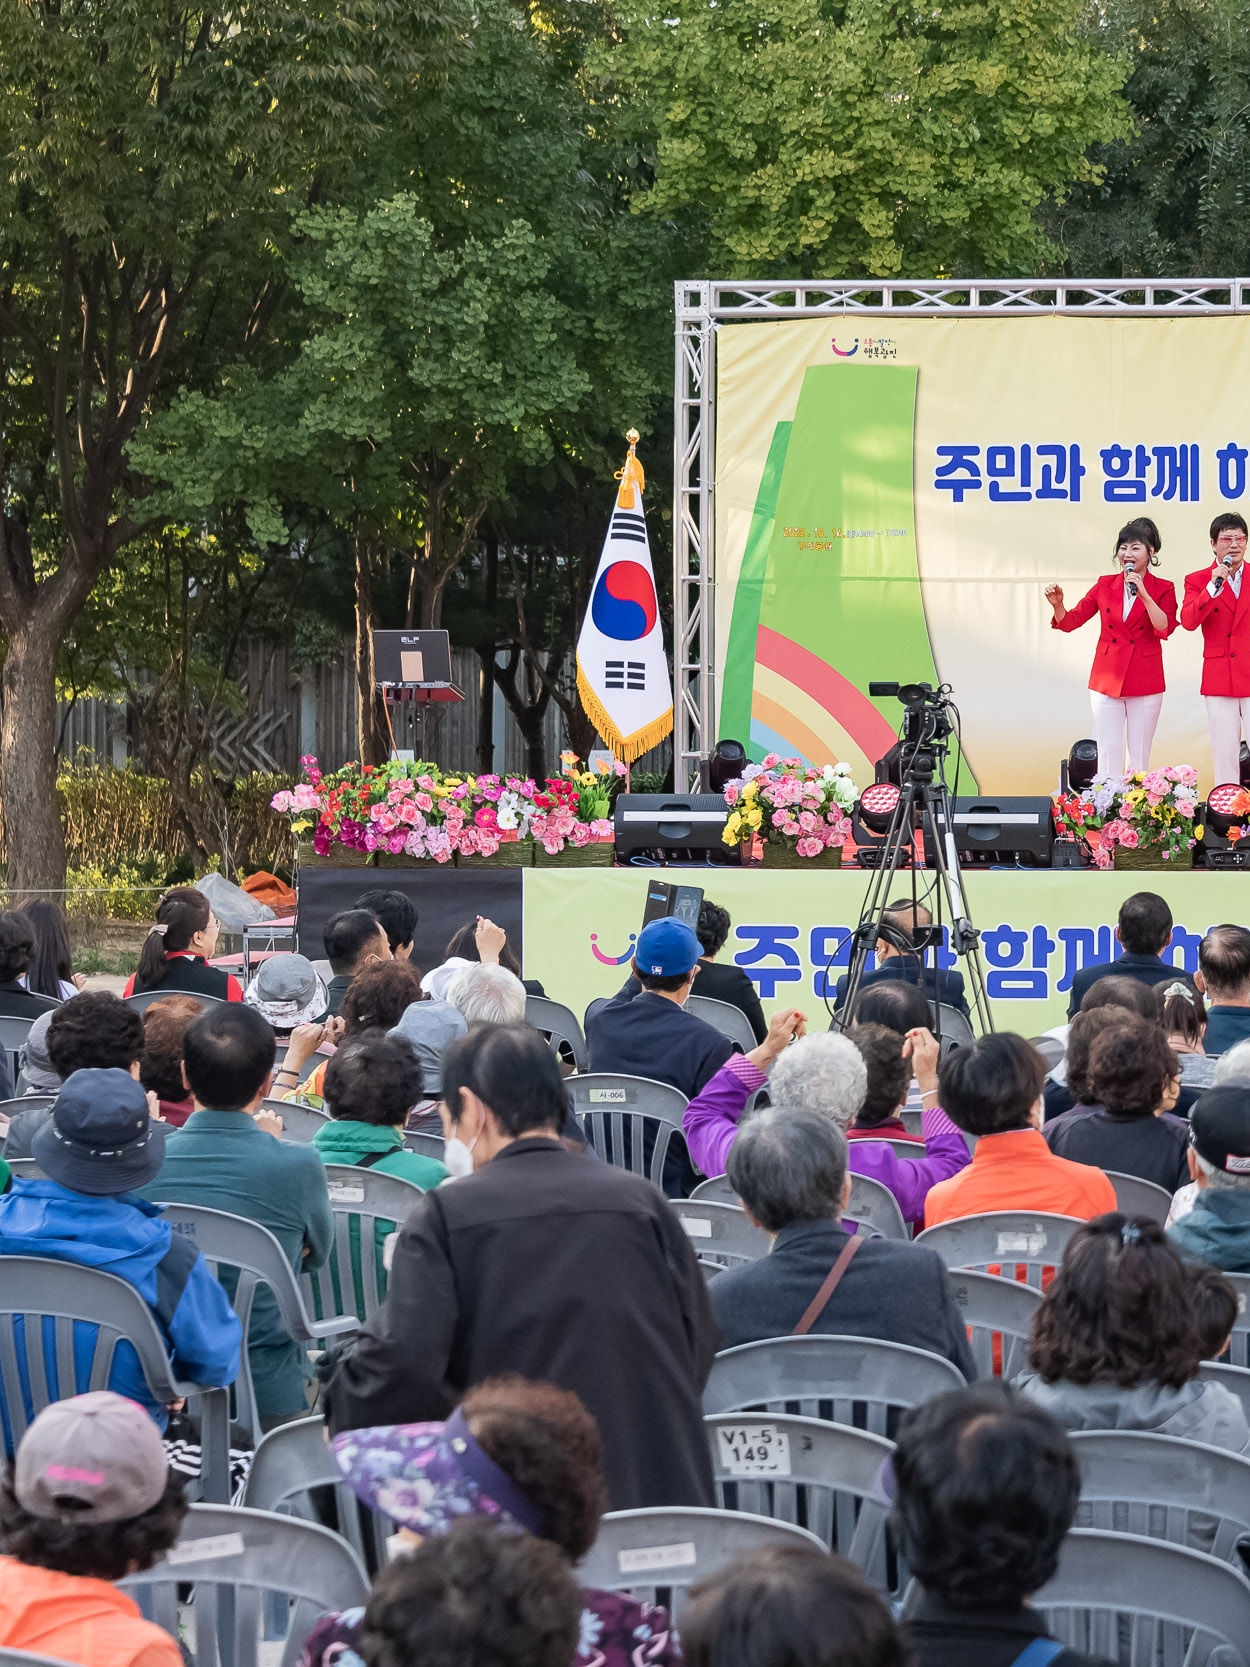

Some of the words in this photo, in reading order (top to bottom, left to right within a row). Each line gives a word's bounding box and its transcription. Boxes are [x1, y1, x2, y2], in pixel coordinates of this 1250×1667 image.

[934, 443, 1086, 503] 주민과
[1099, 443, 1201, 503] 함께
[721, 1428, 773, 1445] V1-5
[732, 1445, 769, 1462] 149
